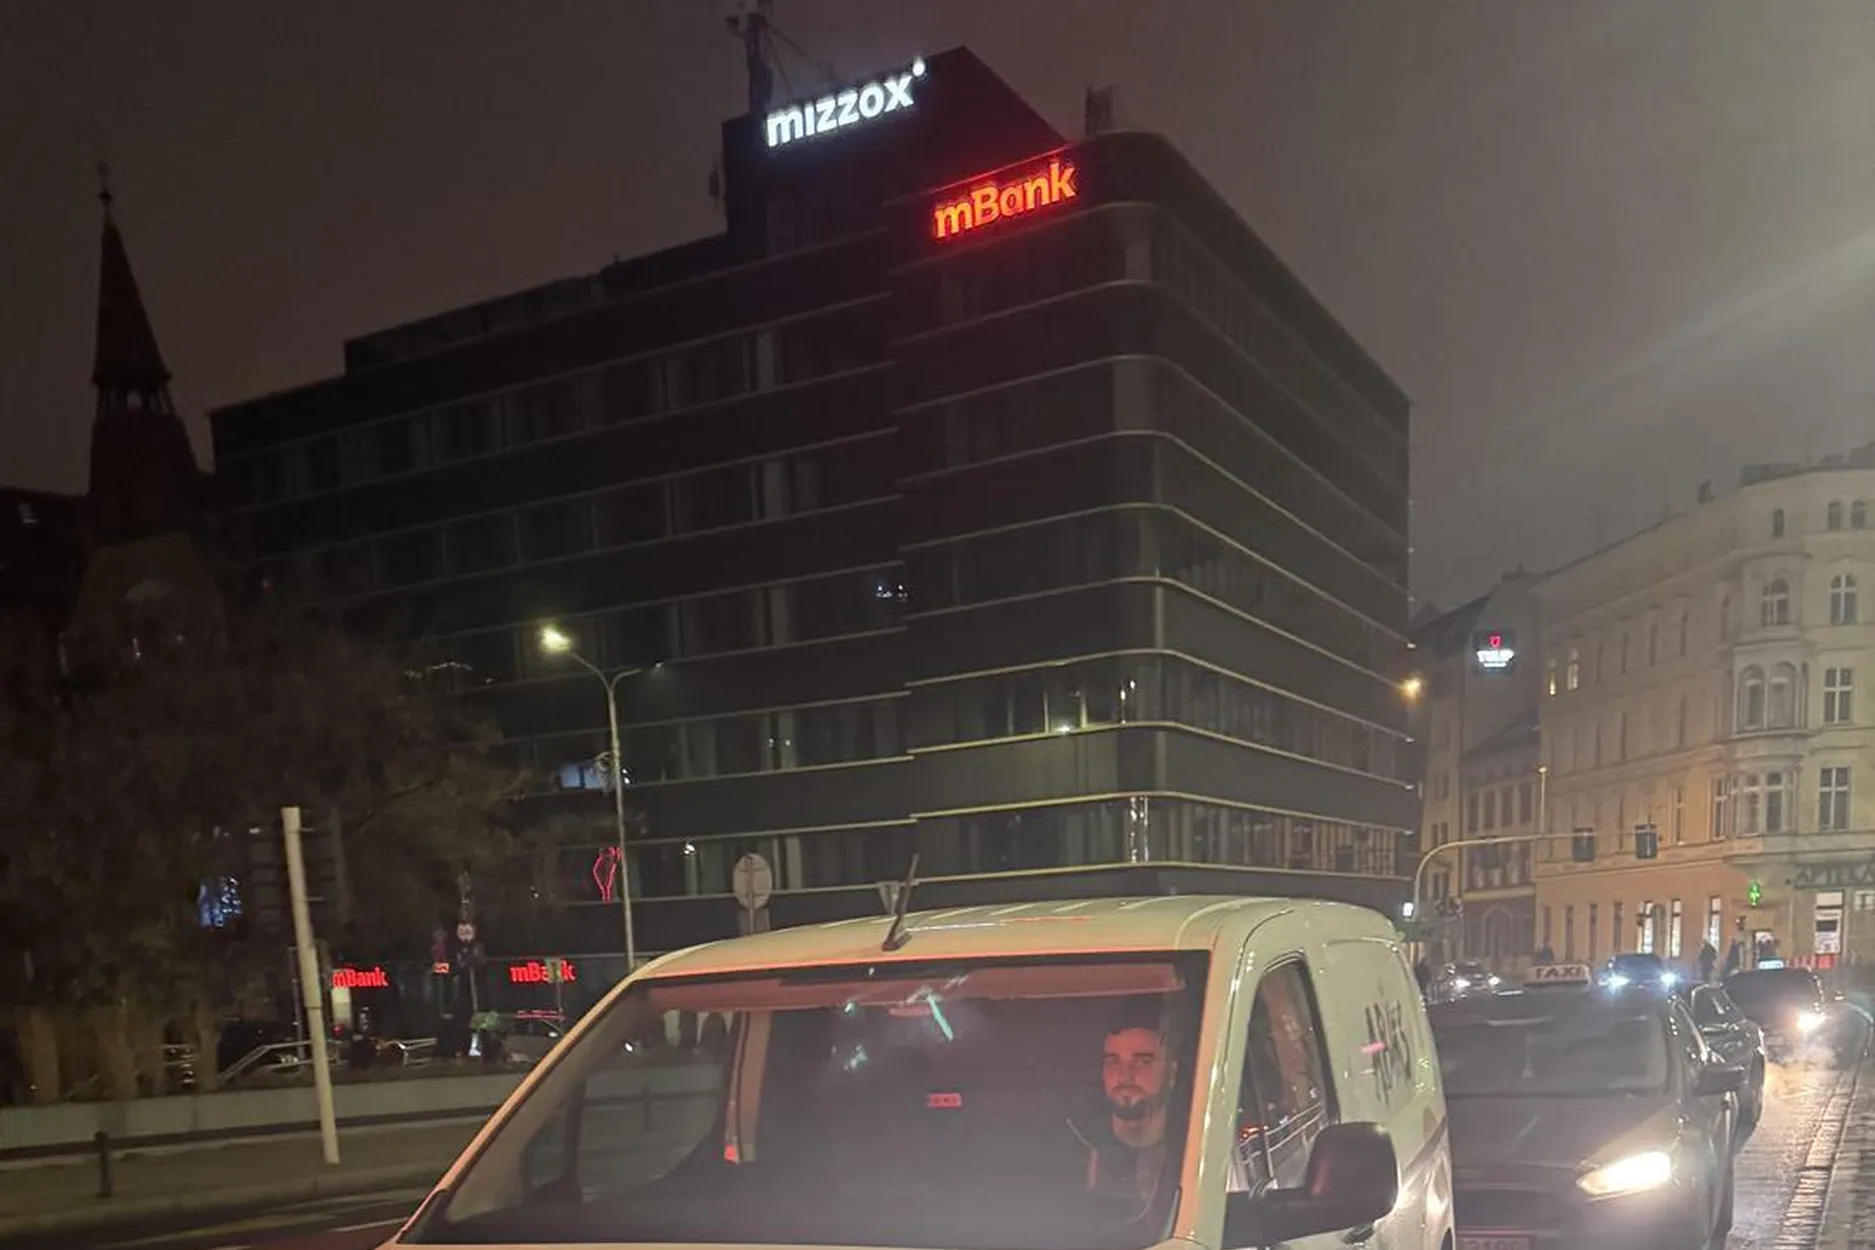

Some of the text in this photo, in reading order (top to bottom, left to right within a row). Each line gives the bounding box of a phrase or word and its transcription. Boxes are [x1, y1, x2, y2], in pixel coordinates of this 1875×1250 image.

[766, 74, 914, 147] mizzox
[934, 161, 1077, 239] mBank
[332, 966, 389, 988] mBank
[510, 960, 576, 982] mBak
[1535, 966, 1585, 980] TAXI
